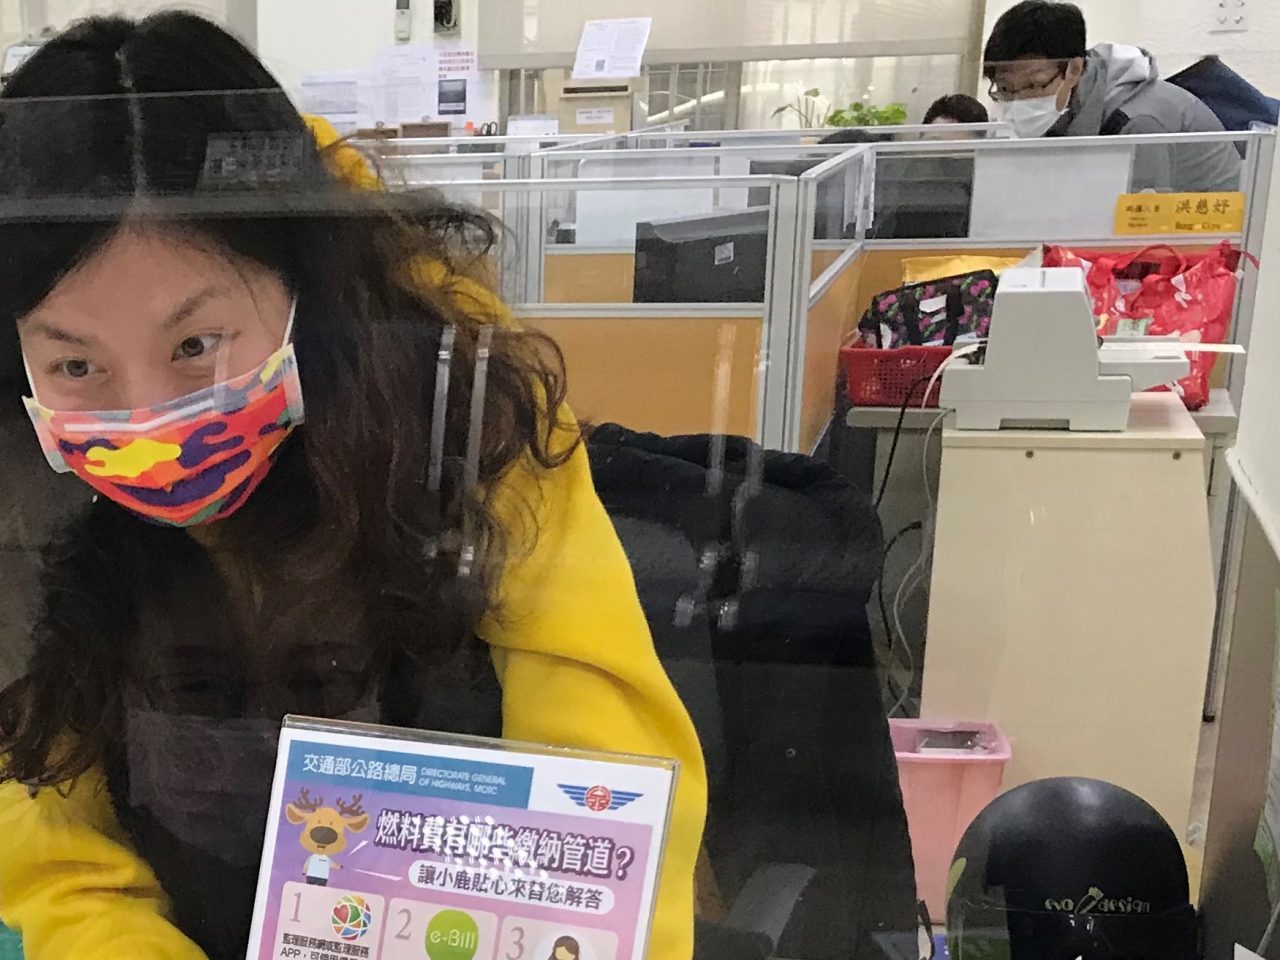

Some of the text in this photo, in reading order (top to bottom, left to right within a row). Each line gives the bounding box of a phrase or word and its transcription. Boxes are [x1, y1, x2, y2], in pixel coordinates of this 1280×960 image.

[302, 753, 418, 785] 交通部公路總局
[420, 766, 507, 786] DIRECTORATE GENERAL
[418, 777, 430, 787] OF
[289, 891, 303, 923] 1
[1097, 896, 1151, 914] design
[393, 907, 413, 941] 2
[425, 928, 476, 950] e-Bill
